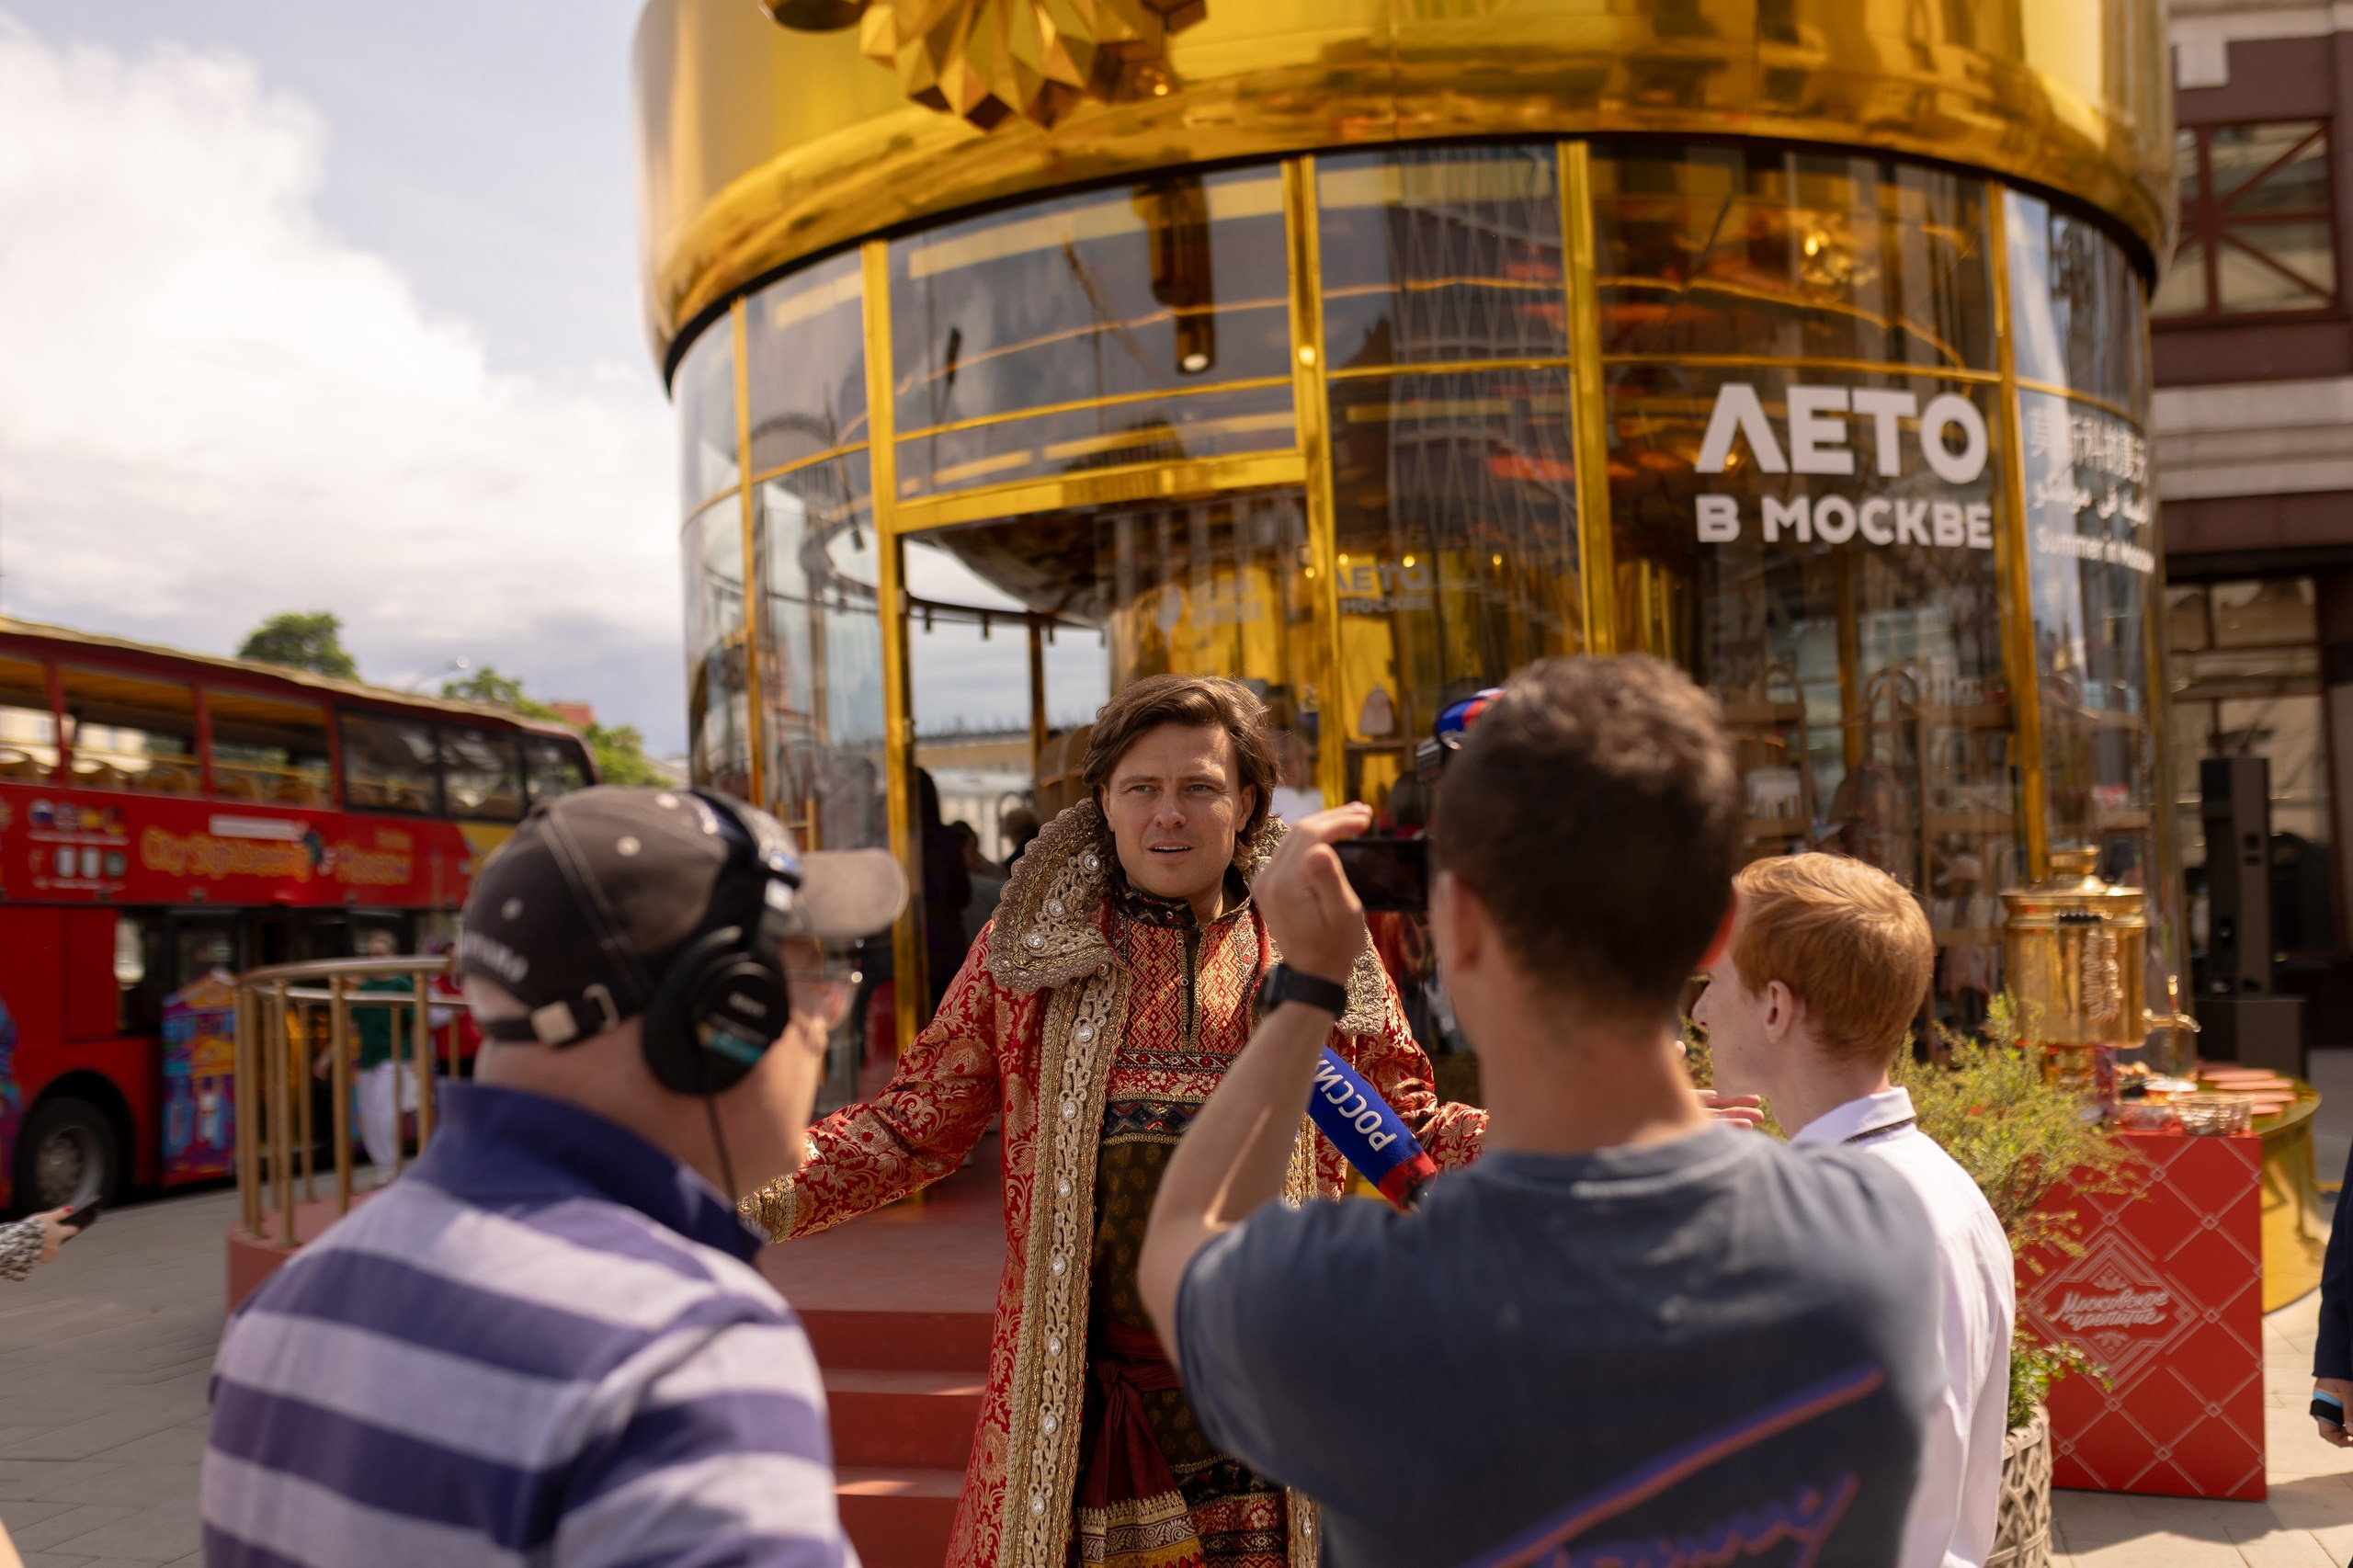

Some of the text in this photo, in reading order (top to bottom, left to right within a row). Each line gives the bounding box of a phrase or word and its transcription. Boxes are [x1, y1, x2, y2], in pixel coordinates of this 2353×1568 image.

[1695, 382, 1989, 484] ЛЕТО
[1695, 494, 1741, 543] В
[1760, 494, 1995, 550] МОСКВЕ
[1313, 1059, 1398, 1153] РОССИ
